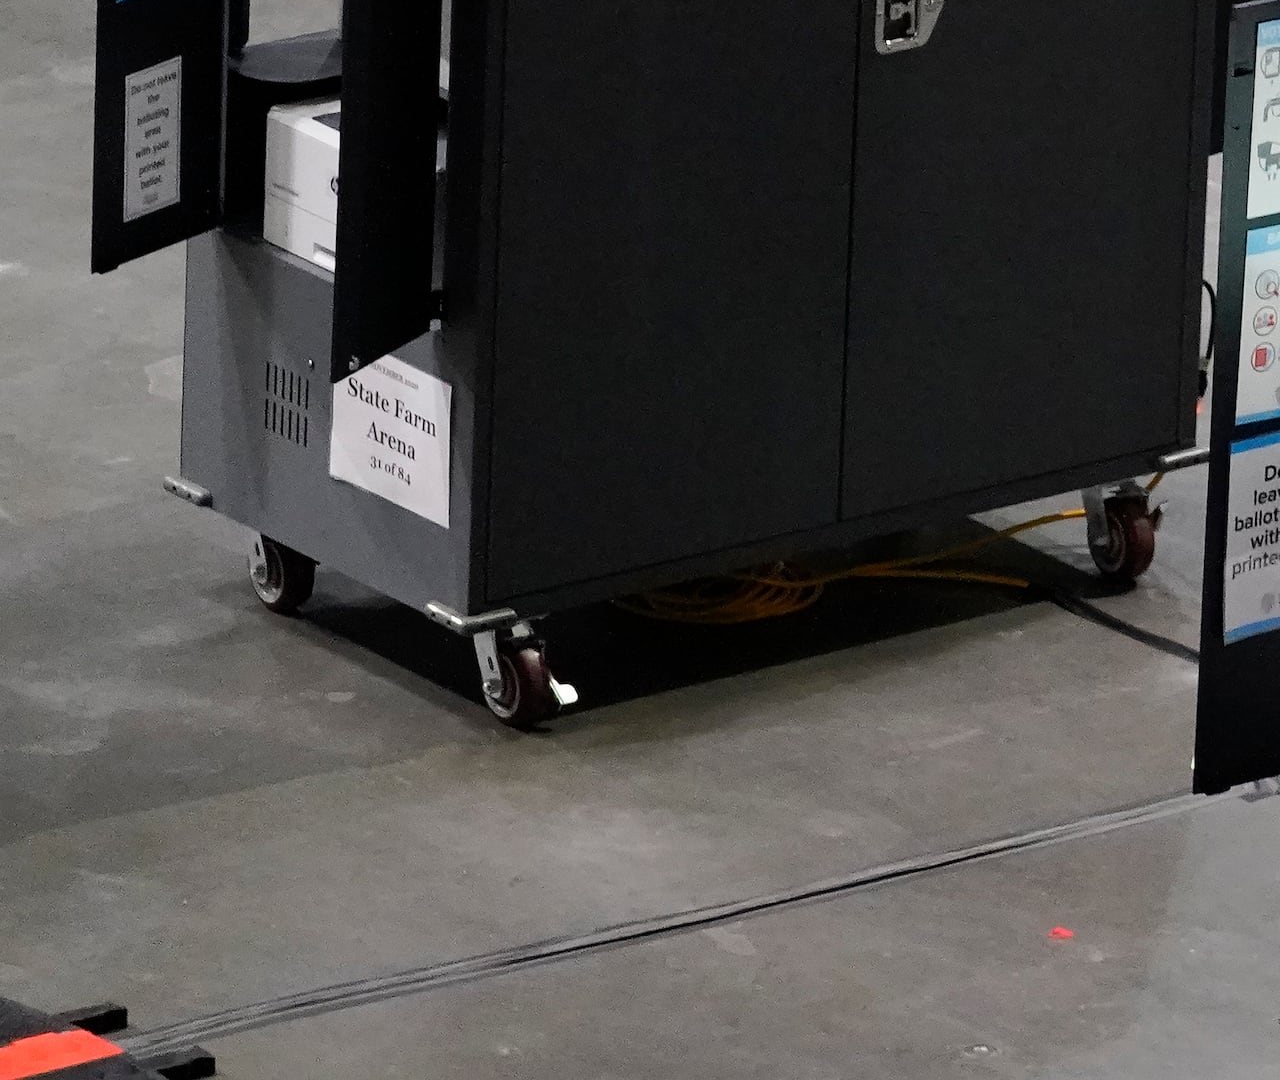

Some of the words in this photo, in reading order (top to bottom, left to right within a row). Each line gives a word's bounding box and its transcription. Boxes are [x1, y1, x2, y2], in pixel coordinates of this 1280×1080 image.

[347, 376, 390, 413] State
[394, 398, 437, 437] Farm
[366, 421, 417, 461] Arena
[384, 462, 397, 476] of
[397, 467, 412, 486] 84
